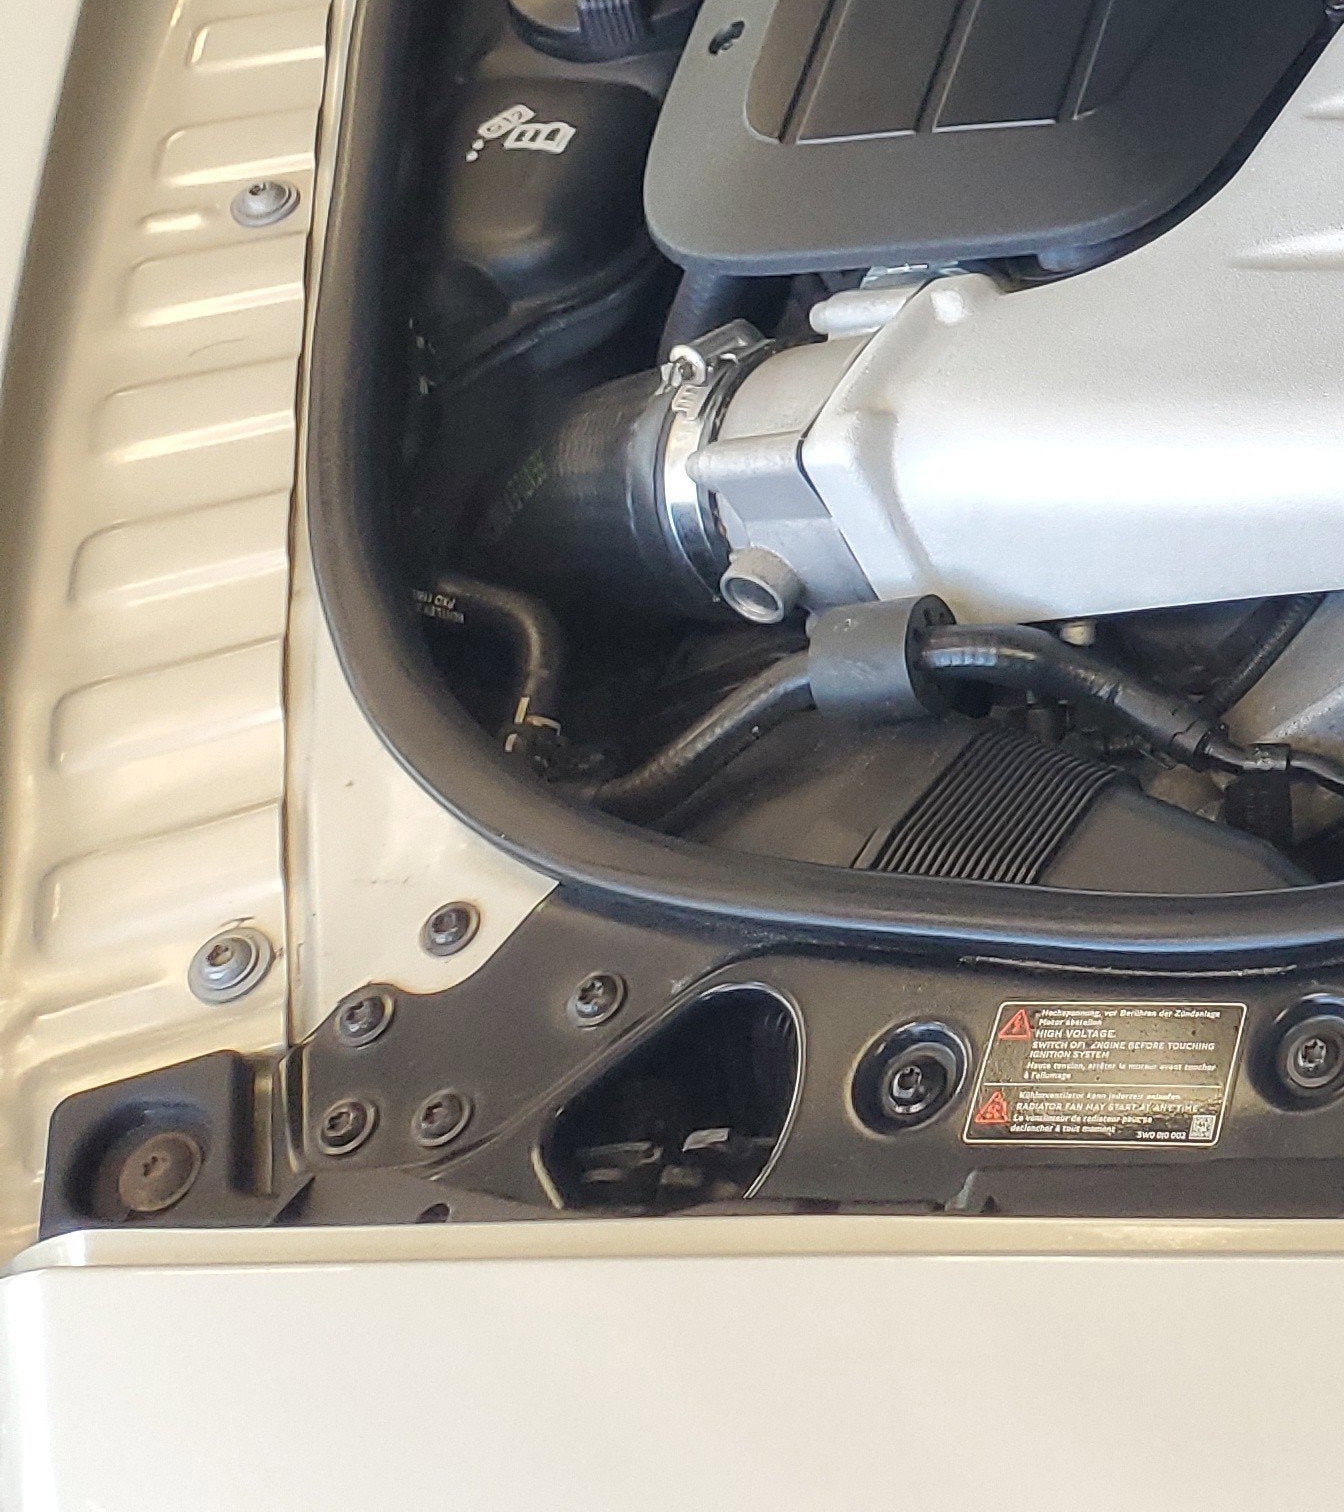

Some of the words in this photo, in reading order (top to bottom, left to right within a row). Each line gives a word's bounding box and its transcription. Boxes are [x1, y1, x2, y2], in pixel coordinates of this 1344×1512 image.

[1035, 1029, 1063, 1038] HIGH
[1032, 1041, 1068, 1049] SWITCH
[1128, 1041, 1165, 1050] BEFORE
[1167, 1042, 1216, 1051] TOUCHING
[1029, 1050, 1071, 1059] IGNITION
[1073, 1050, 1110, 1059] SYSTEM
[1016, 1102, 1063, 1111] RADIATOR
[1065, 1102, 1083, 1111] FAN
[1085, 1102, 1108, 1112] MAY
